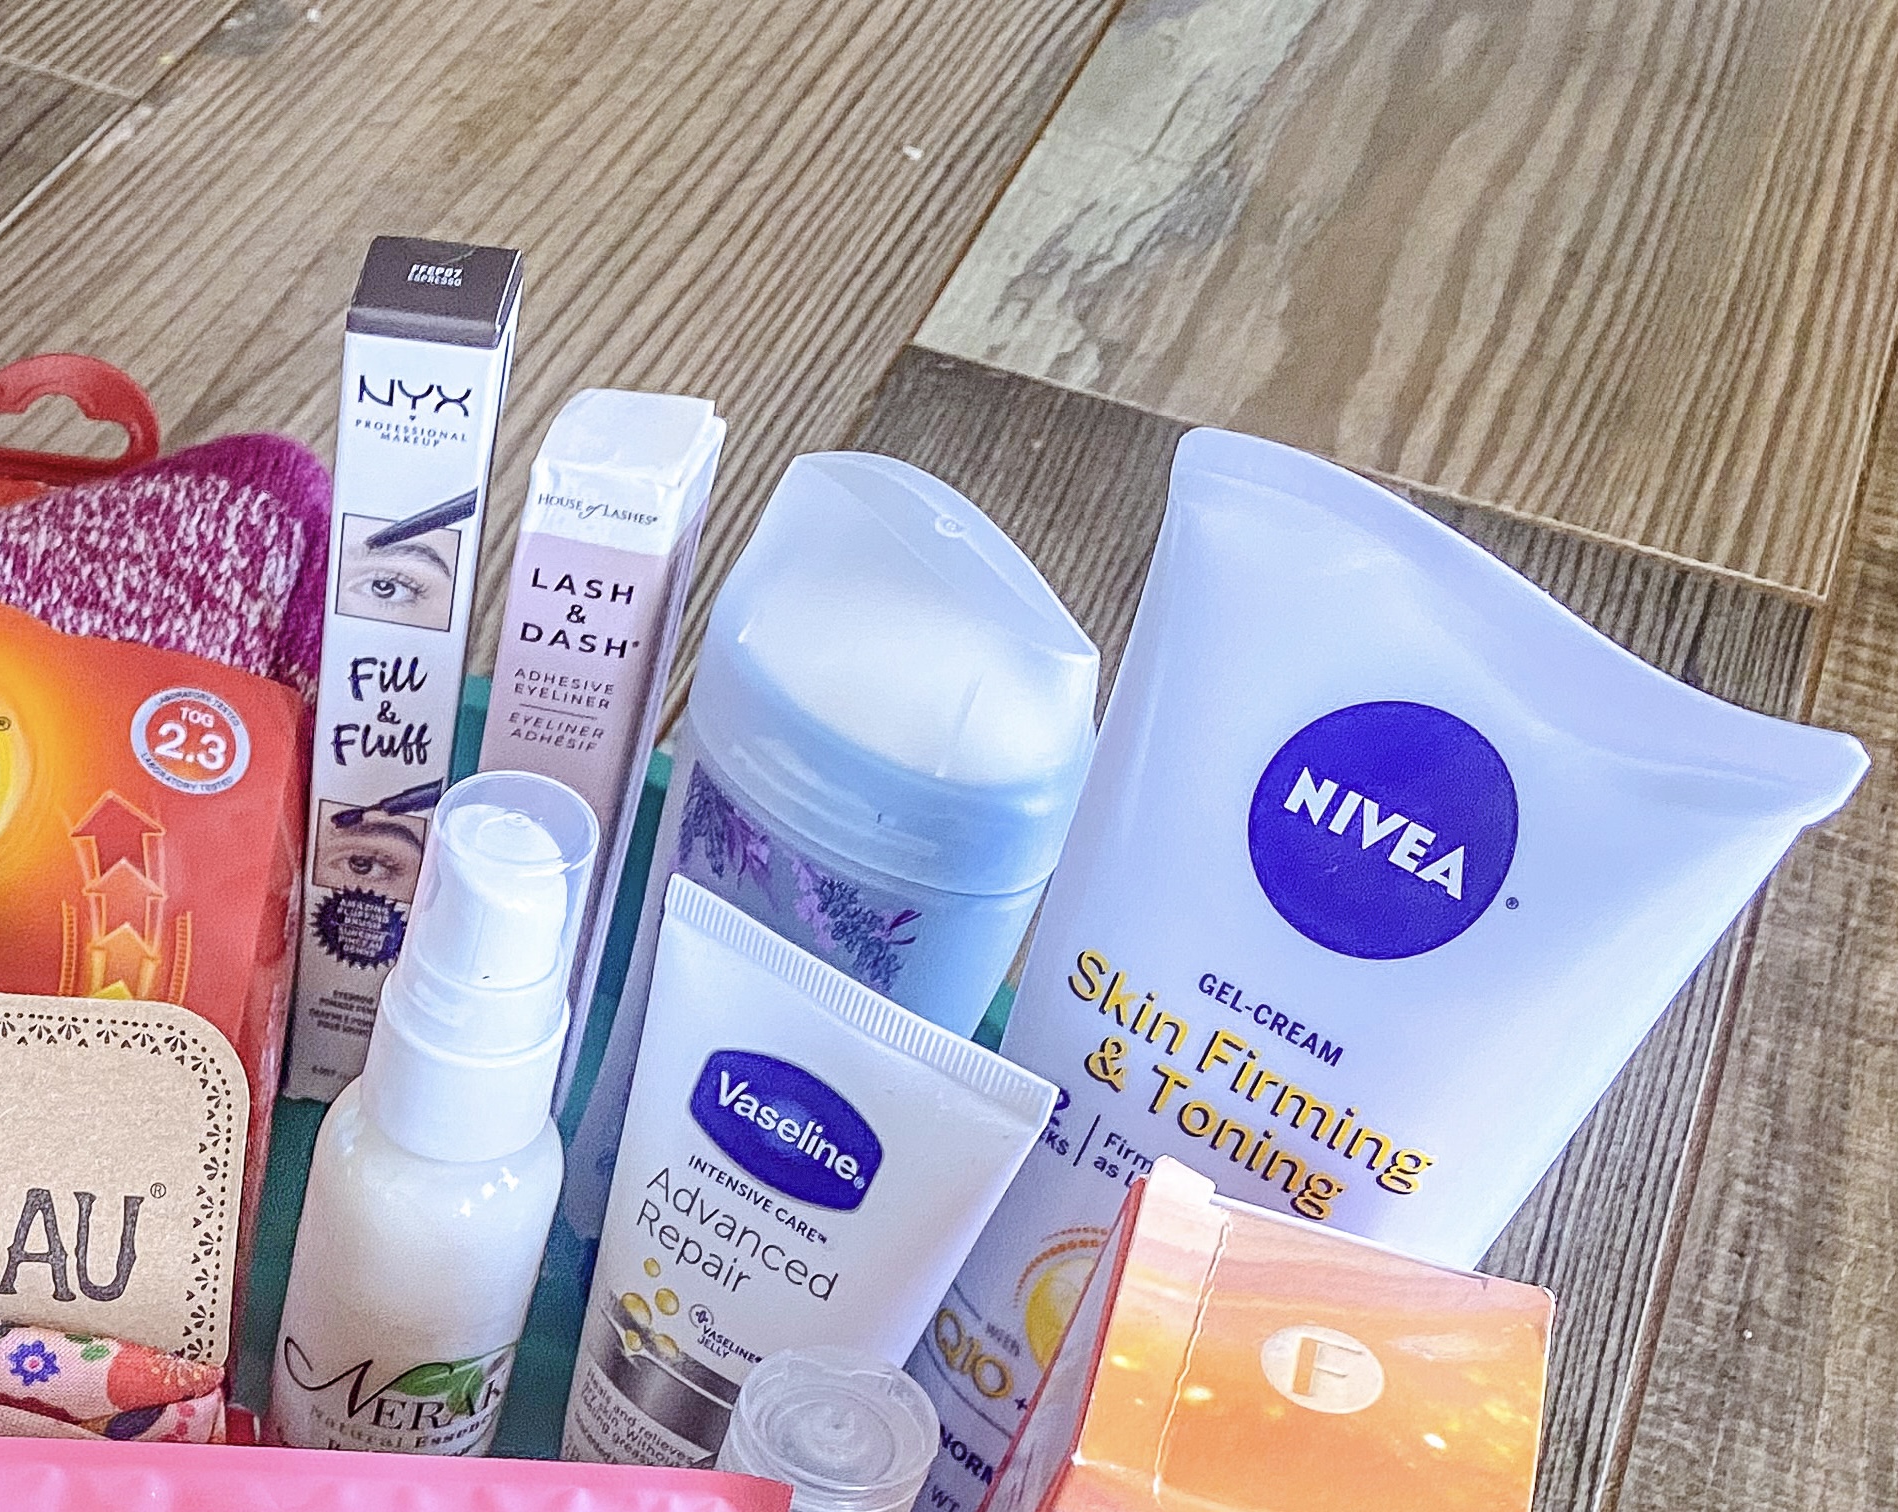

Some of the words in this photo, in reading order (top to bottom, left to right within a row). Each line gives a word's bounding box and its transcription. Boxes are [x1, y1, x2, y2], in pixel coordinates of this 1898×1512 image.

[357, 374, 473, 420] NYX
[354, 419, 468, 443] PROFESSIONAL
[380, 433, 441, 448] MAKEUP
[538, 493, 583, 511] HOUSE
[531, 567, 634, 605] LASH
[566, 604, 585, 624] &
[348, 656, 429, 702] Fill
[514, 668, 615, 696] ADHESIVE
[514, 682, 611, 710] EYELINER
[180, 707, 214, 728] TOG
[376, 700, 402, 725] &
[508, 711, 605, 740] EYELINER
[155, 722, 227, 770] 2.3
[331, 723, 432, 766] Fluff
[1283, 765, 1467, 901] NIVEA
[1197, 971, 1345, 1069] GEL-CREAM
[1066, 947, 1188, 1058] Skin
[1195, 1028, 1440, 1197] Firming
[1083, 1034, 1129, 1094] &
[1146, 1064, 1345, 1222] Toning
[687, 1153, 773, 1218] INTENSIVE
[633, 1202, 753, 1296] Repair
[644, 1165, 842, 1304] Advanced
[697, 1336, 730, 1360] JELLY
